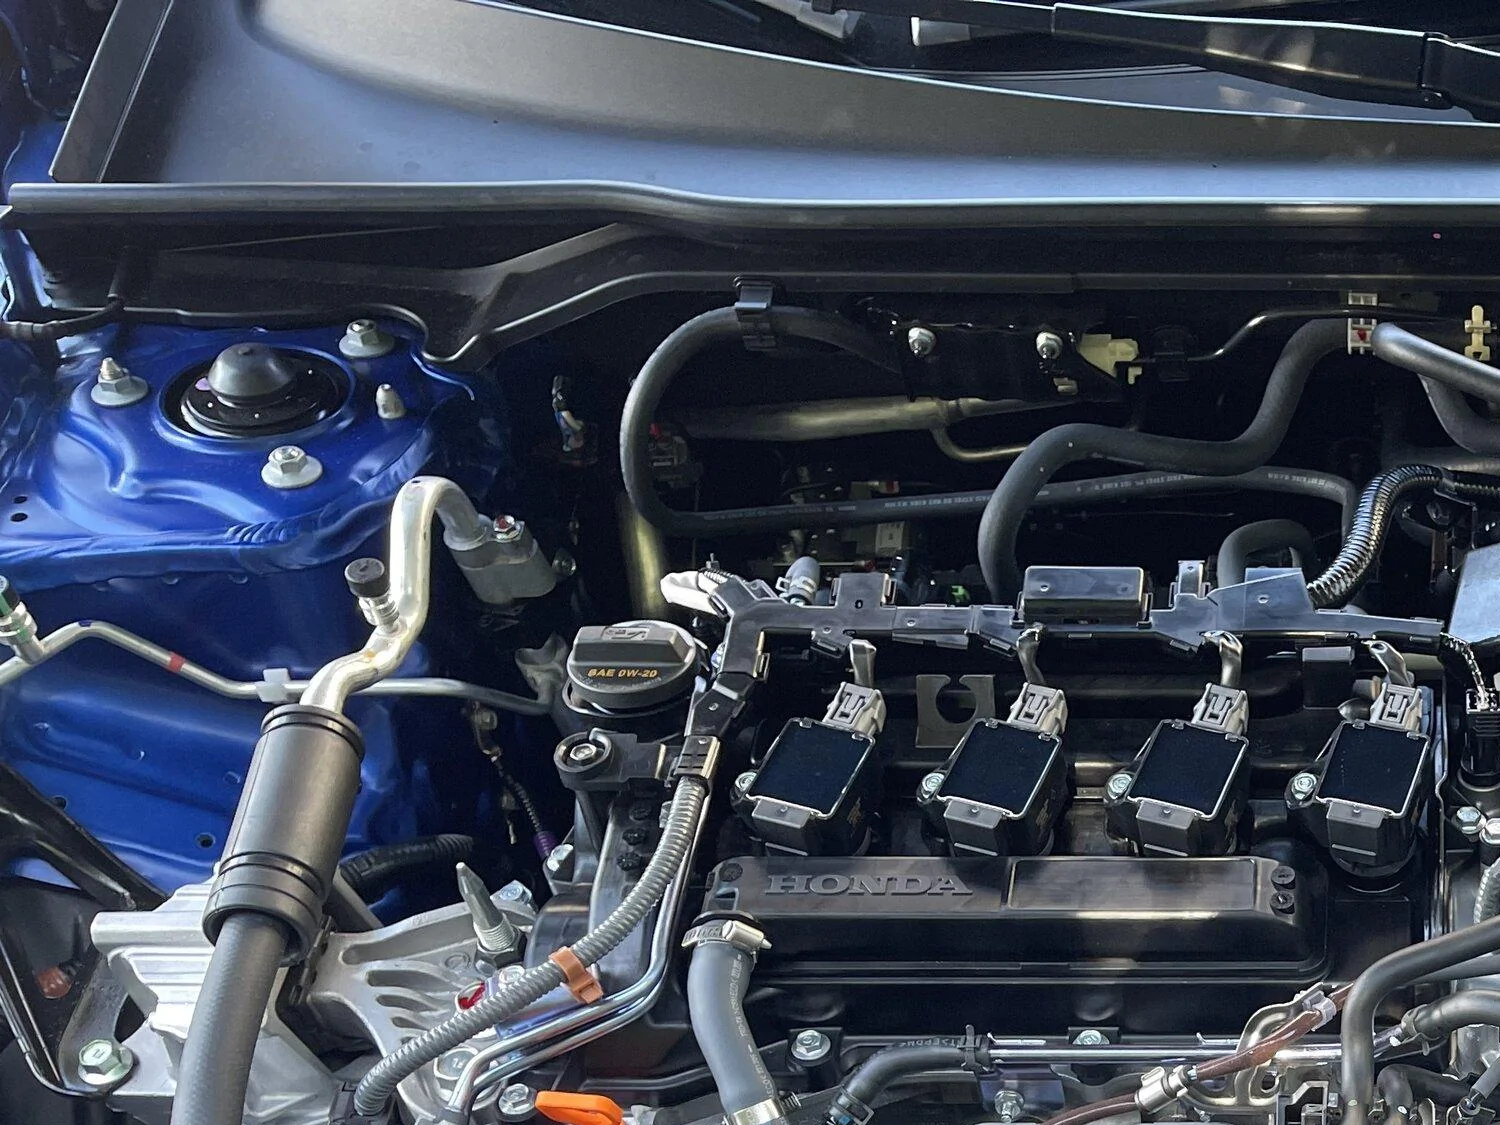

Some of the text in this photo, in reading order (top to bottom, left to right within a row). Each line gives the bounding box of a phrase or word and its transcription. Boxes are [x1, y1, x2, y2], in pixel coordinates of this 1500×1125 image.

[587, 668, 658, 678] SAE 0W-20
[764, 874, 973, 896] HONDA
